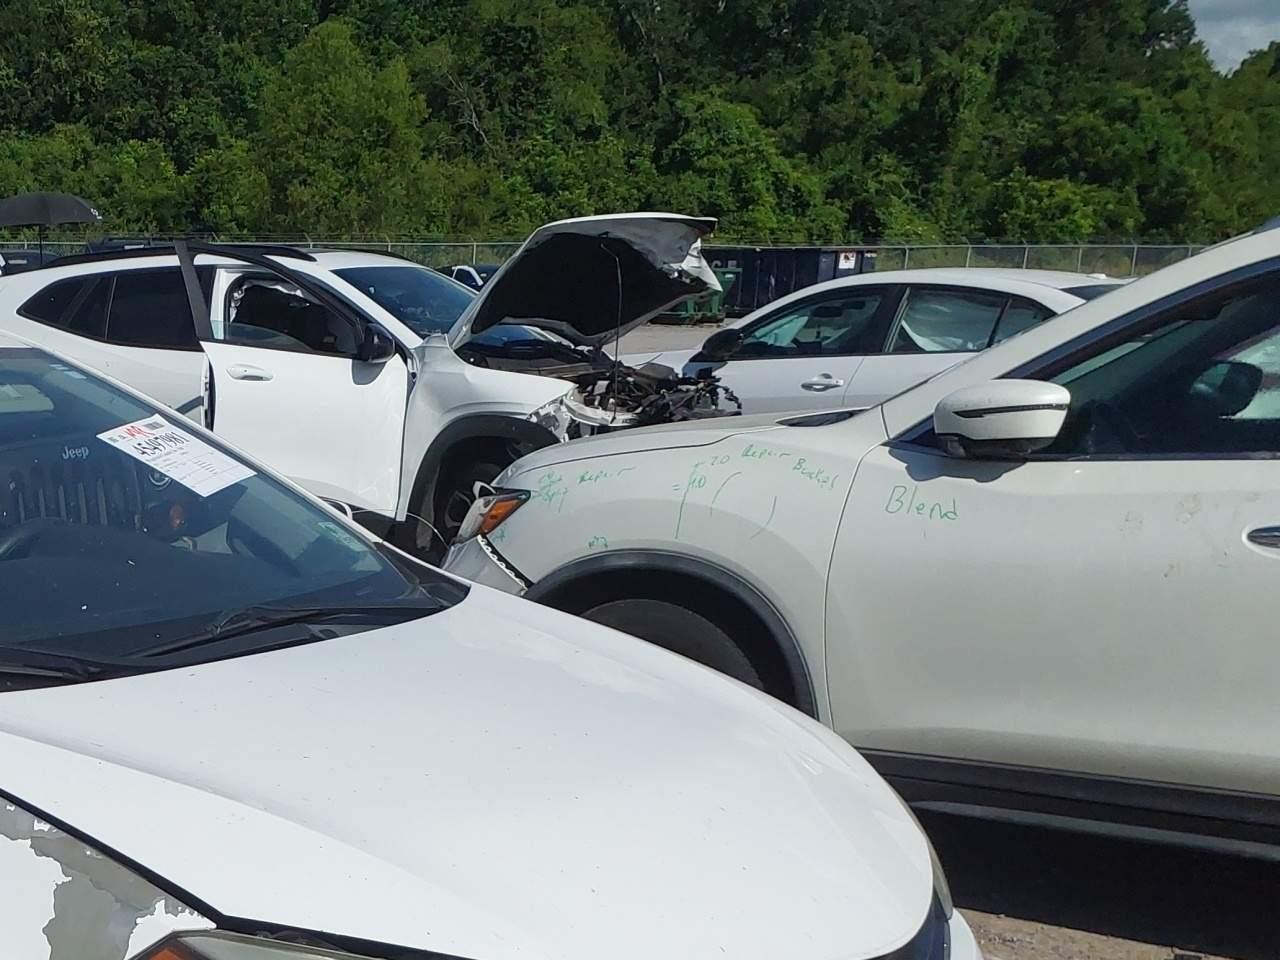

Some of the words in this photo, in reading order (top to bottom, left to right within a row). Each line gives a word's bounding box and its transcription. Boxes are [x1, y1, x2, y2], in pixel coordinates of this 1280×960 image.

[62, 446, 89, 460] Jeep
[132, 431, 190, 457] 45497981
[884, 485, 960, 521] Blend
